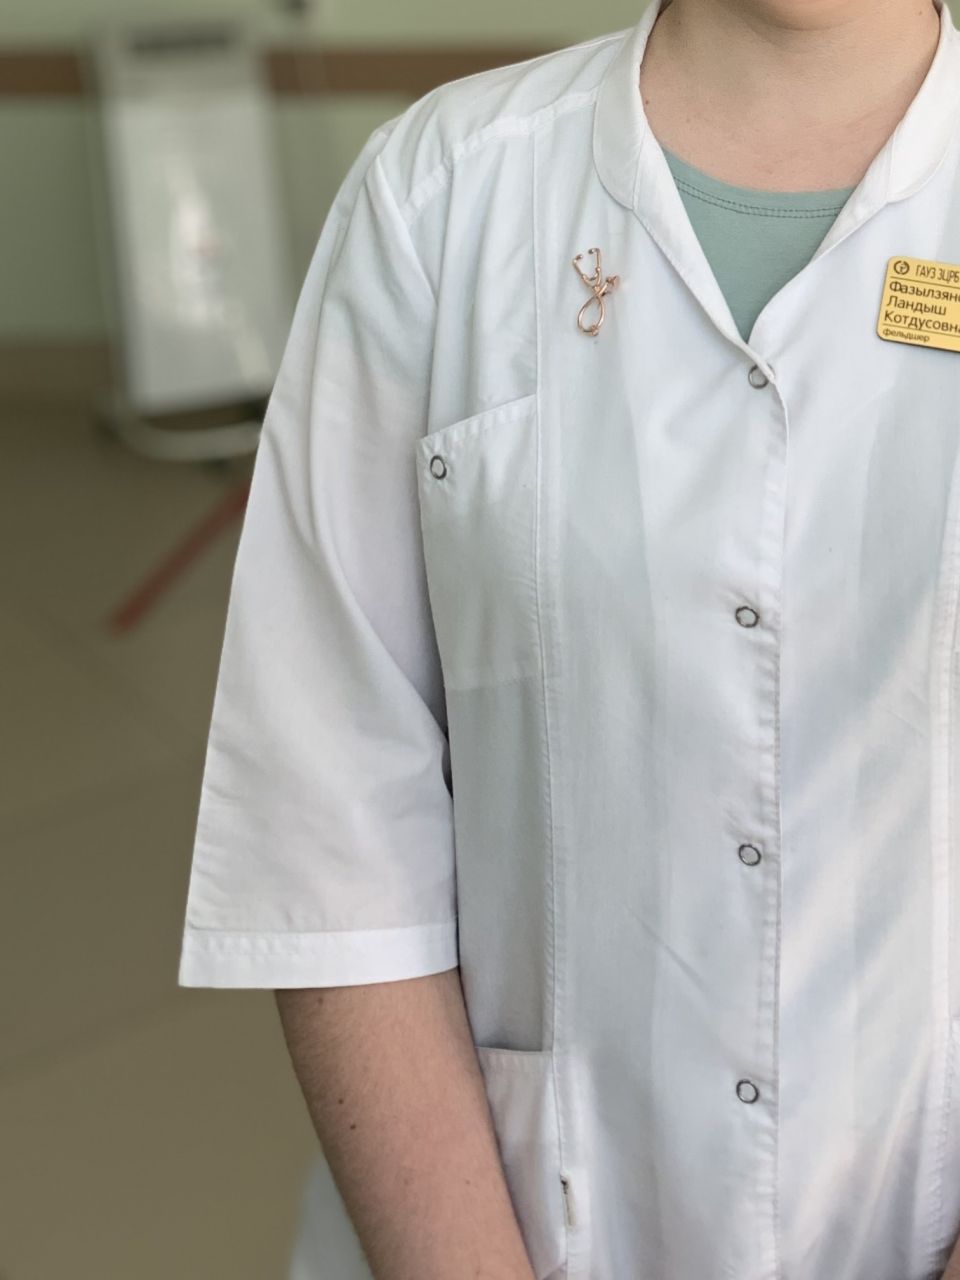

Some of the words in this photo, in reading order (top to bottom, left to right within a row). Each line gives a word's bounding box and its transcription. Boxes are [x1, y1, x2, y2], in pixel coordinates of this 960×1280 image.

[915, 265, 936, 280] ГАУЗ
[886, 295, 947, 316] Ландыш
[882, 328, 930, 342] фельдшер
